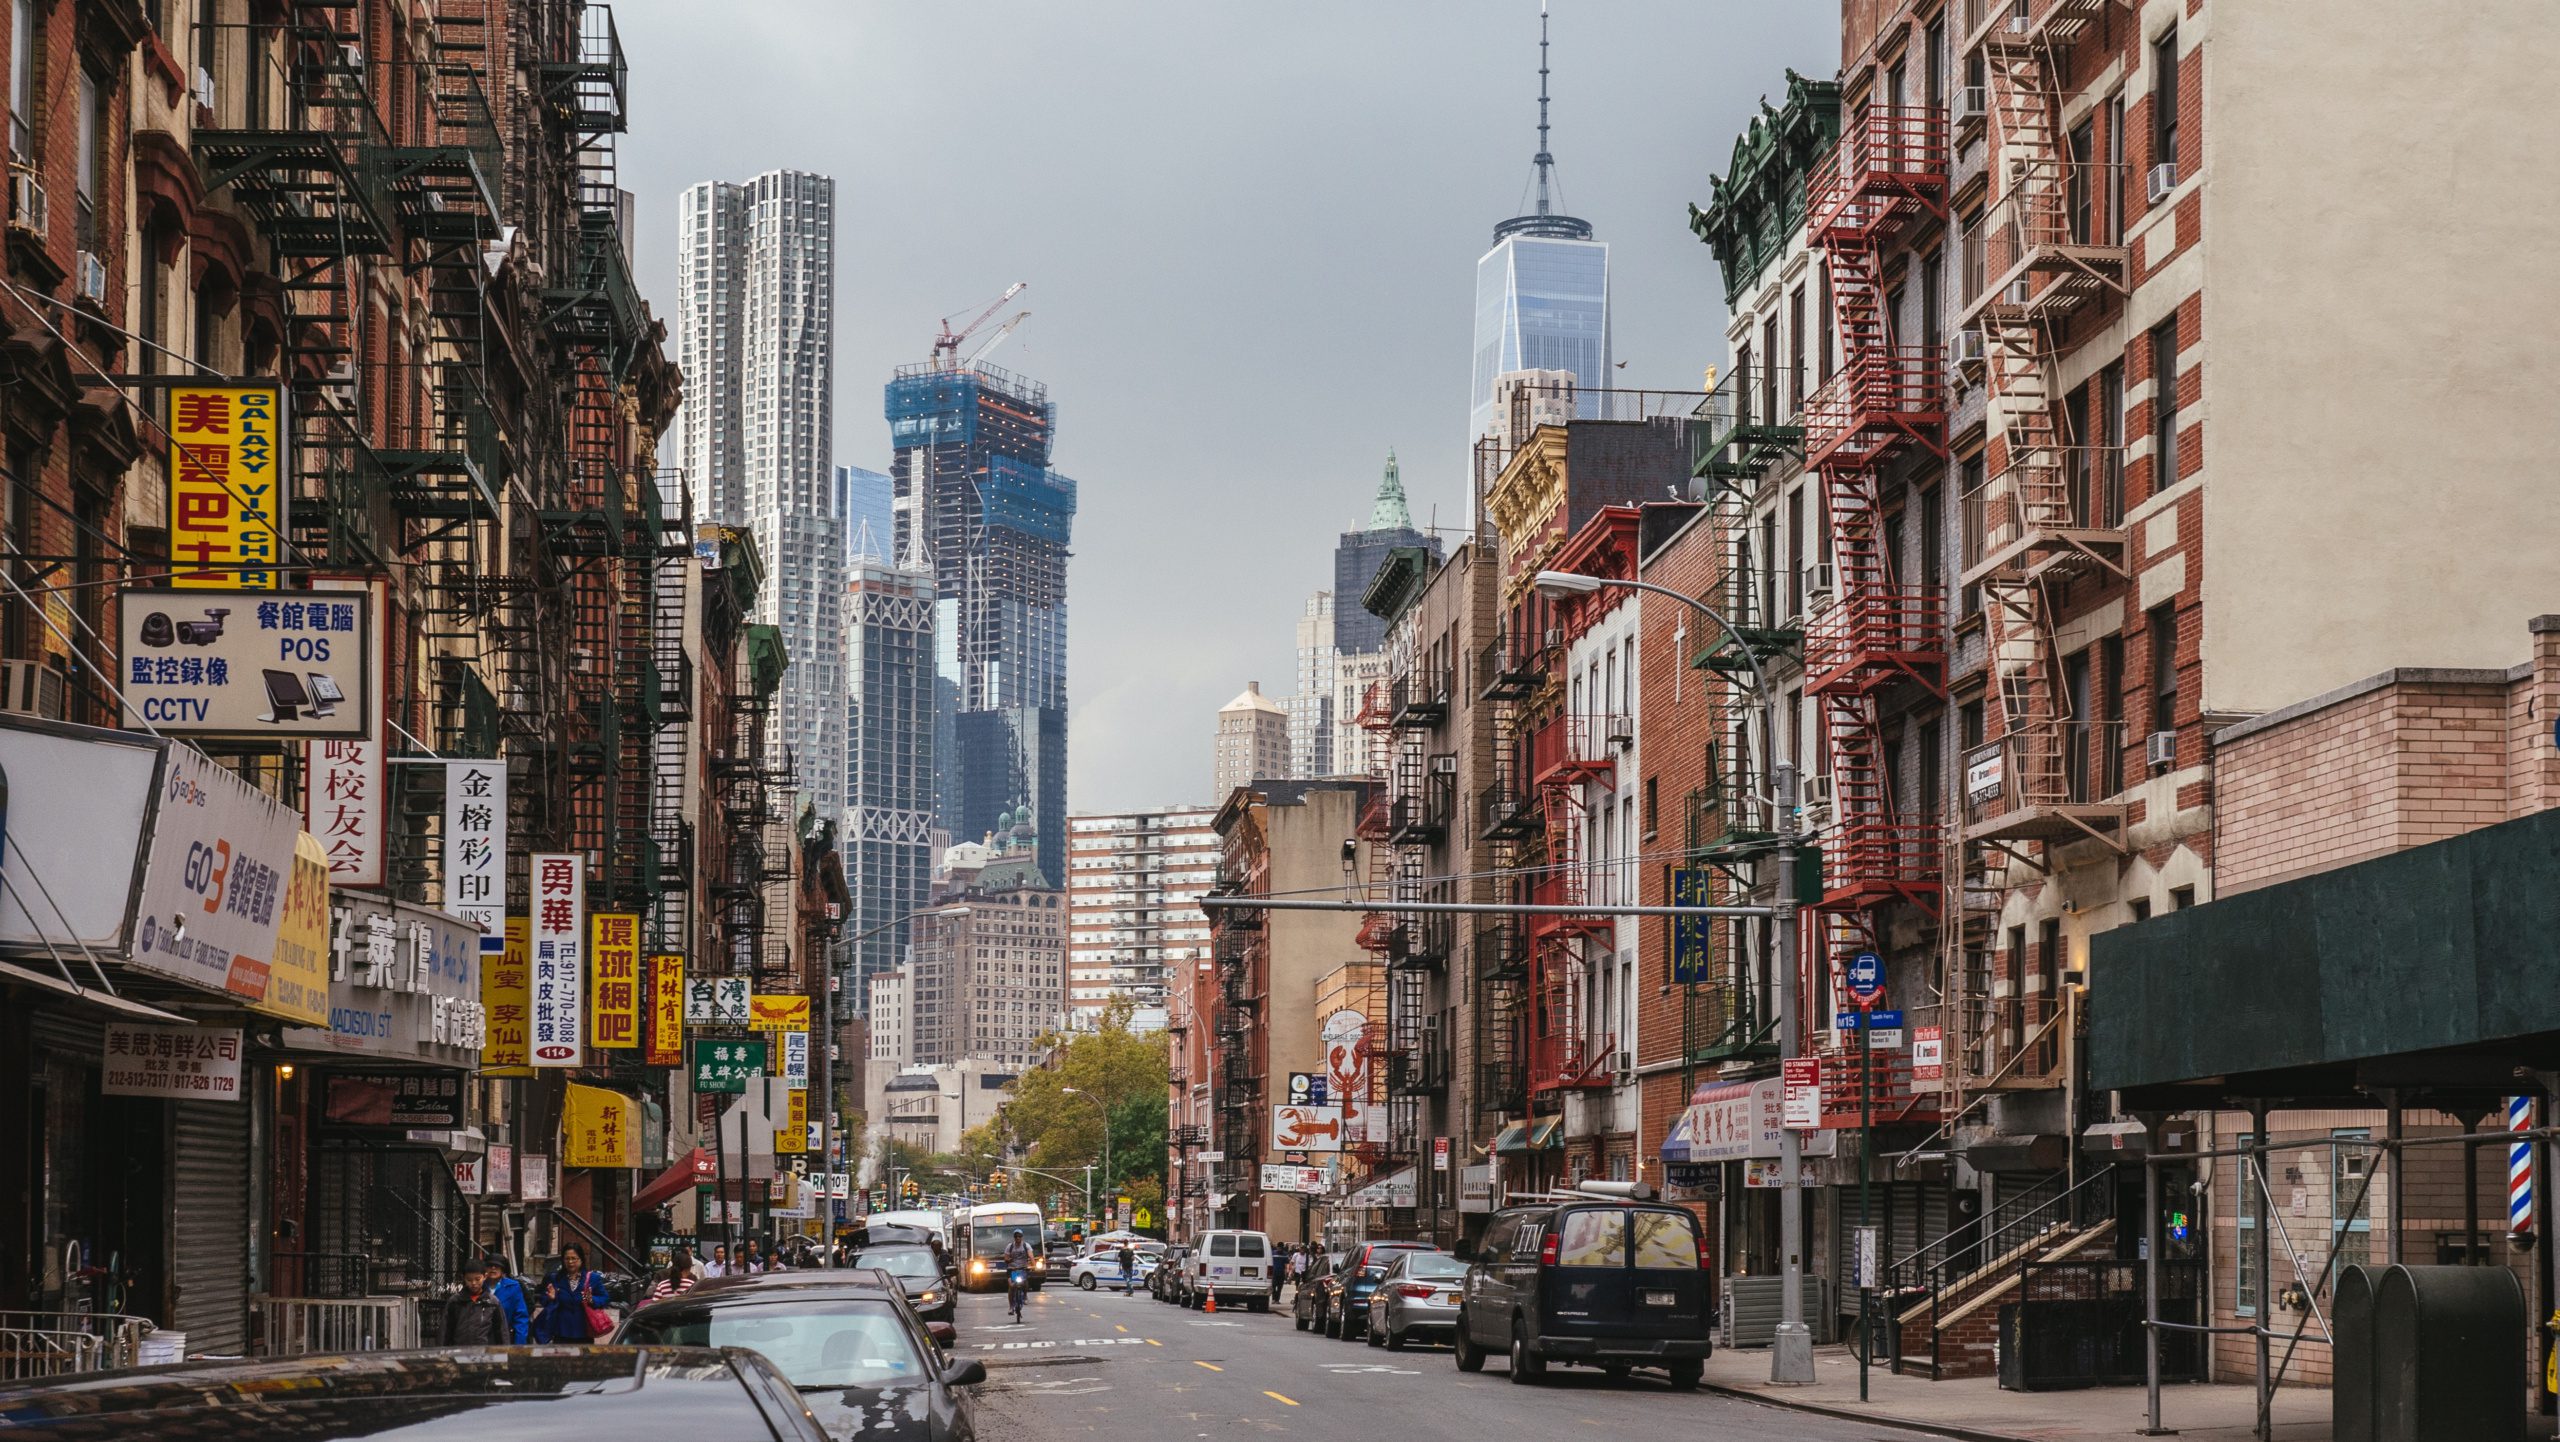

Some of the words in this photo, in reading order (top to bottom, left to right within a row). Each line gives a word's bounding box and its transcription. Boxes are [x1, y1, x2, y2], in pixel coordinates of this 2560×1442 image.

[239, 394, 271, 473] GALAXY
[177, 394, 231, 581] 美雲巴士
[239, 484, 270, 522] VIP
[256, 600, 354, 633] 餐館電腦
[281, 637, 331, 662] POS
[143, 697, 210, 721] CCTV
[458, 768, 493, 902] 金榕彩印
[184, 838, 231, 915] GO3
[226, 851, 280, 928] 餐館電腦
[541, 858, 574, 935] 勇華
[460, 910, 492, 924] JIN'S
[598, 918, 633, 1042] 環球網吧
[658, 957, 682, 1022] 新林肯
[691, 978, 746, 1003] 台灣
[329, 1007, 376, 1037] MADISON
[378, 1014, 392, 1038] ST.
[689, 1003, 748, 1017] 美容院
[1838, 1015, 1855, 1028] M15
[544, 1048, 566, 1058] 114
[213, 1076, 234, 1092] 1729
[700, 1081, 708, 1089] FU
[414, 1099, 450, 1111] Salon
[792, 1089, 804, 1136] 電器行
[600, 1105, 621, 1154] 新林肯
[786, 1140, 797, 1148] 98
[455, 1164, 475, 1182] RK
[1264, 1172, 1272, 1183] 16
